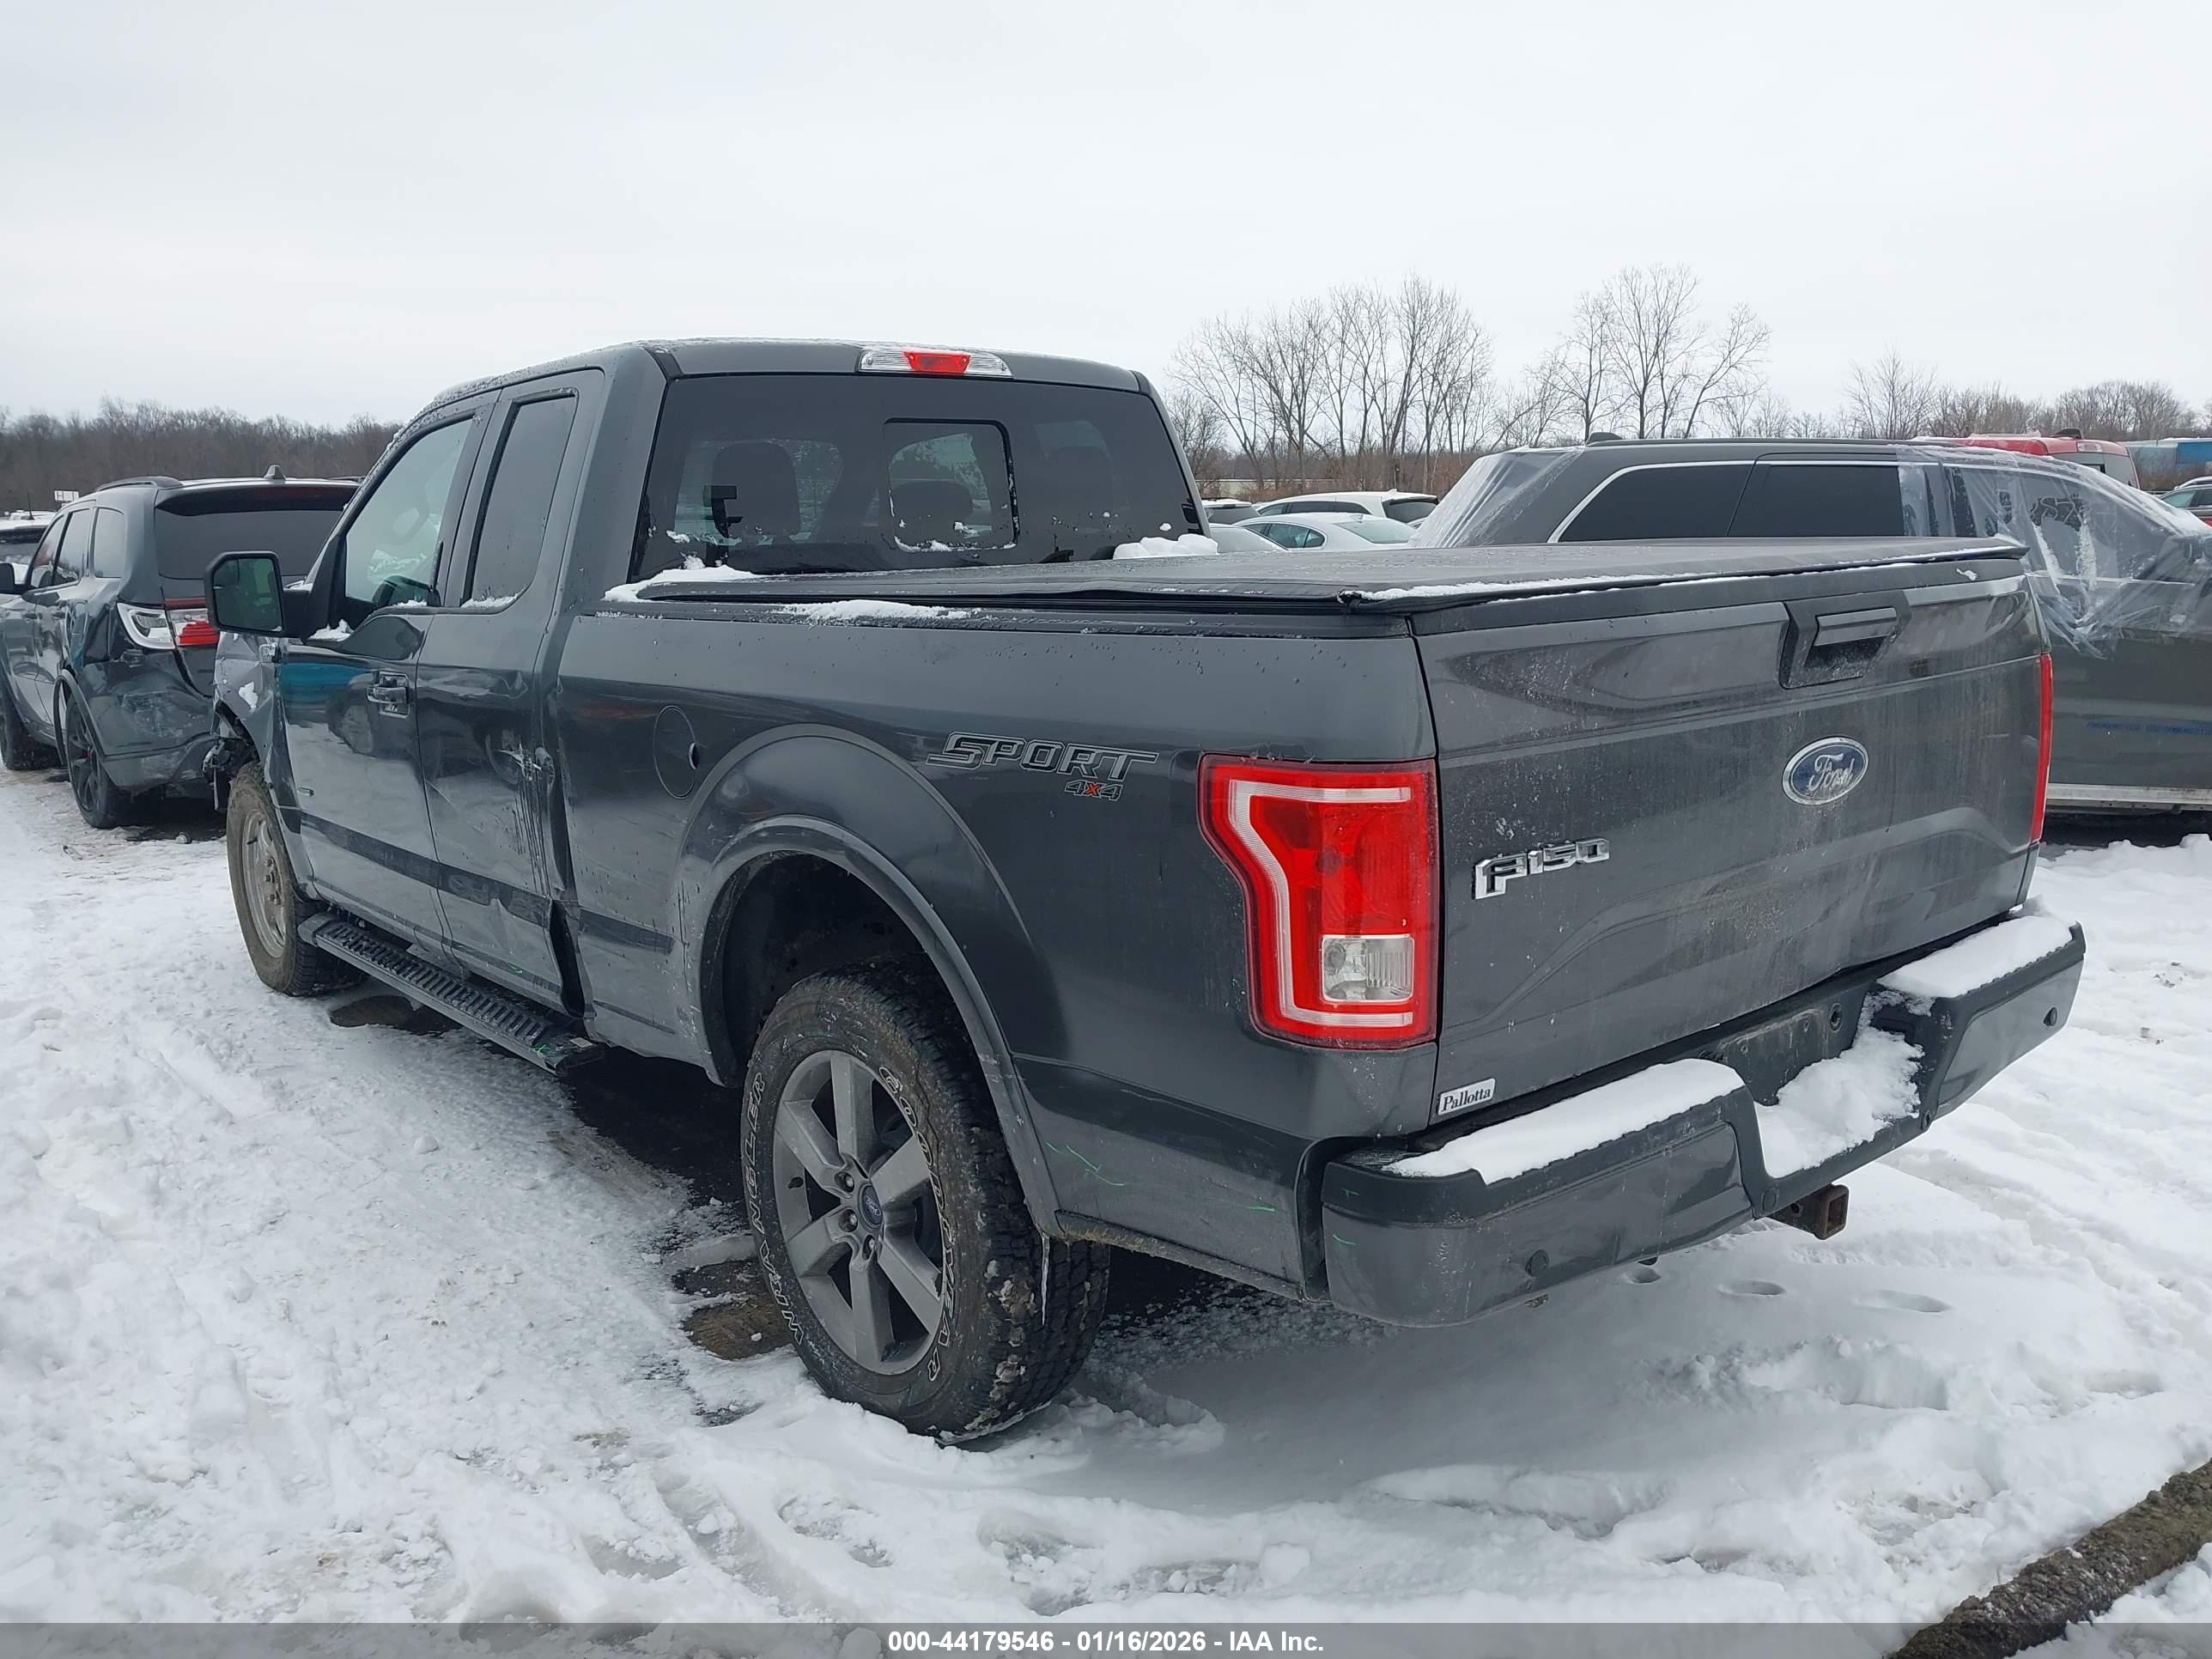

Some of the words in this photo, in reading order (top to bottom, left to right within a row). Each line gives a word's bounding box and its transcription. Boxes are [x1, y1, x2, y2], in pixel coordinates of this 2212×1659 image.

[927, 732, 1159, 781] SPORT
[1807, 752, 1855, 791] Ford
[1441, 1088, 1491, 1112] Pallotta
